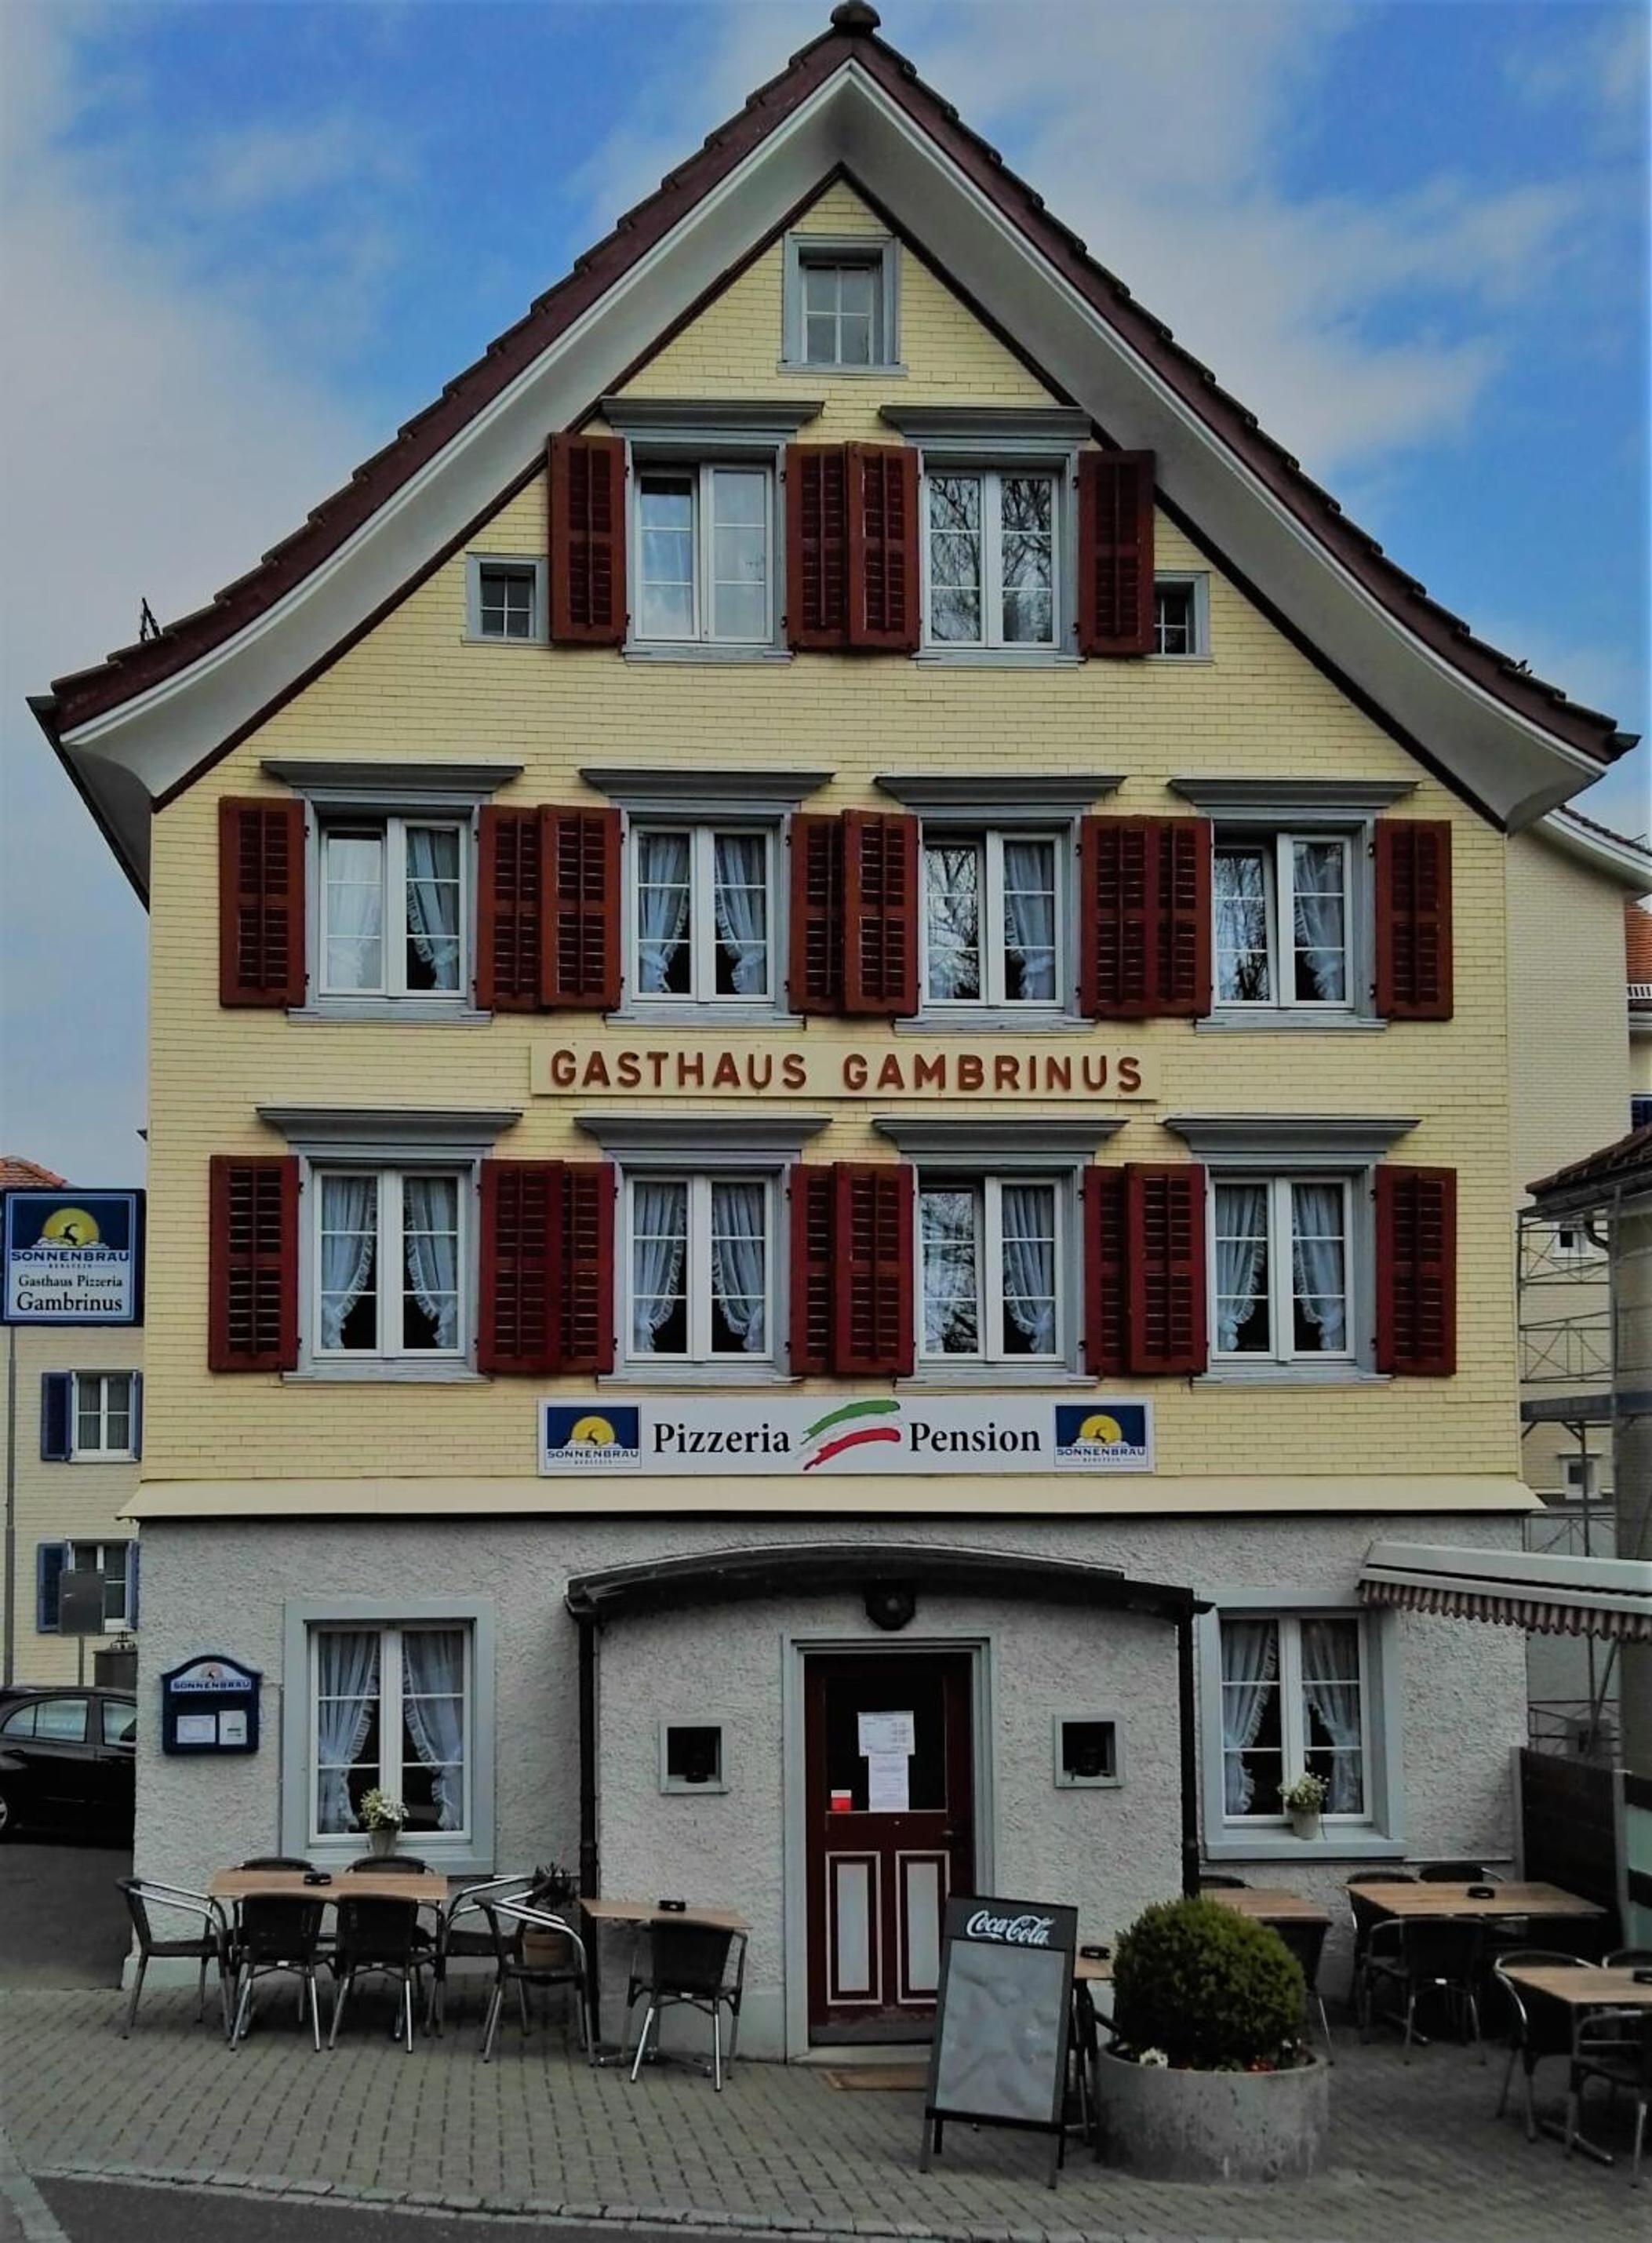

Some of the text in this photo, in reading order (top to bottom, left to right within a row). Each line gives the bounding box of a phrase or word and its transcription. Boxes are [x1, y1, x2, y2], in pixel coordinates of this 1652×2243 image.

[550, 1049, 1143, 1093] GASTHAUS GAMBRINUS
[19, 1274, 123, 1287] Gasthaus Pizzeria
[16, 1291, 123, 1312] Gambrinus
[653, 1422, 1042, 1454] Pizzeria Pension
